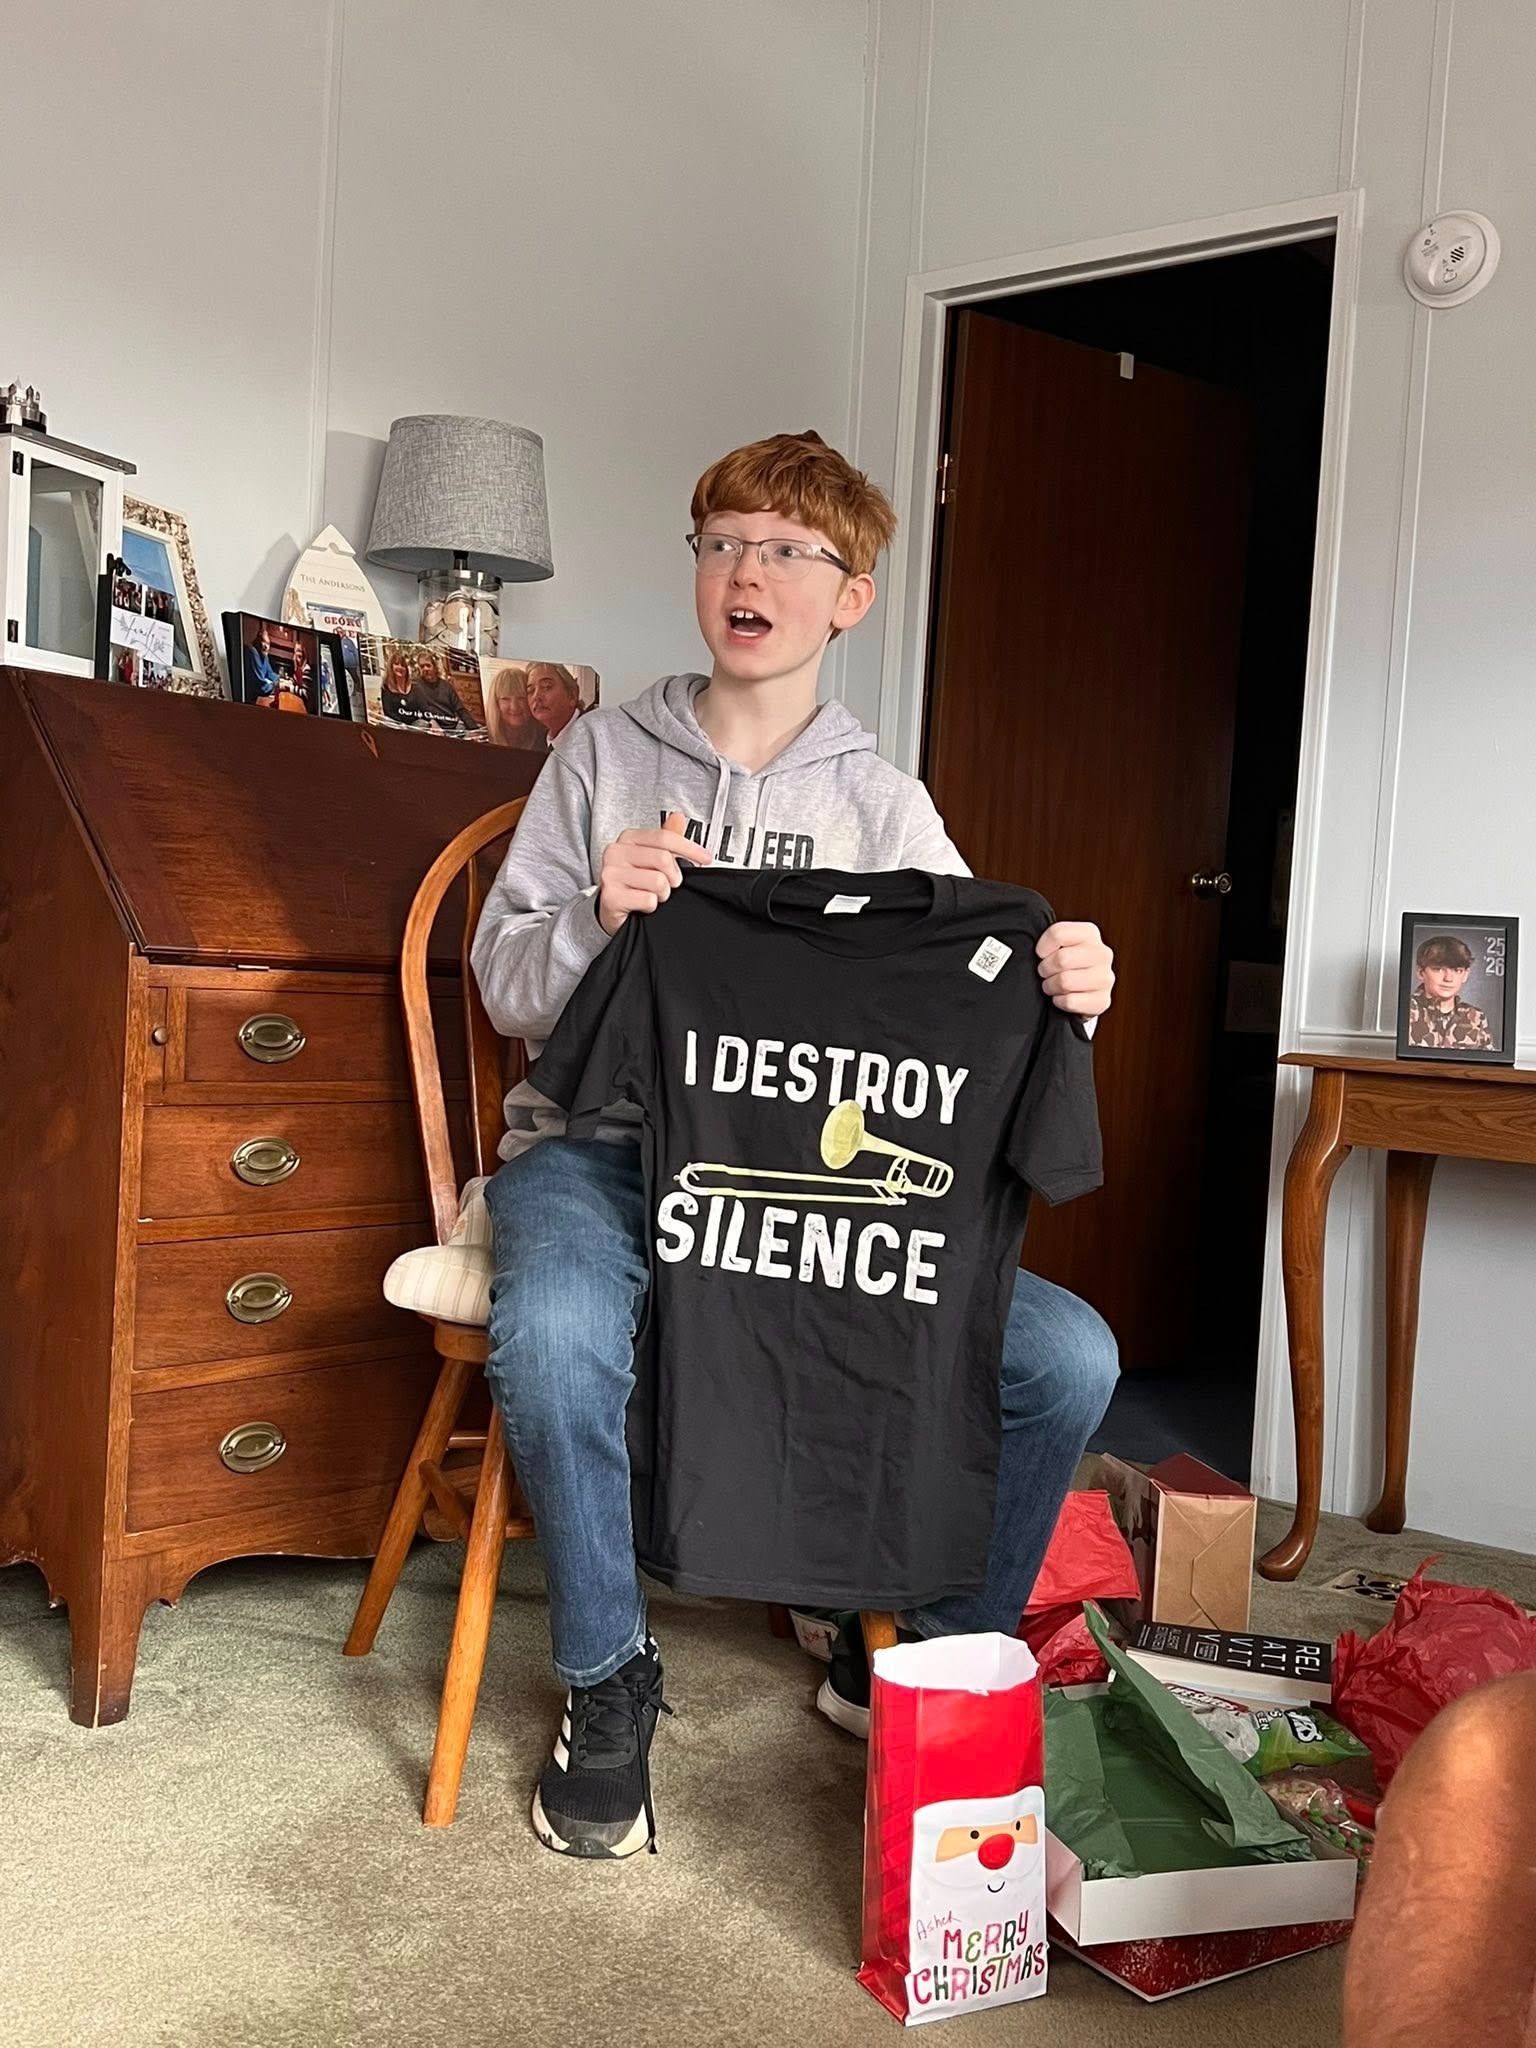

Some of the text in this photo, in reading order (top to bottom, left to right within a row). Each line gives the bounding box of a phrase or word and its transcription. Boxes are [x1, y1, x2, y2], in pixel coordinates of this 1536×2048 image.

[300, 574, 365, 592] THE ANDERSONS
[684, 1030, 969, 1124] I DESTROY
[656, 1191, 946, 1305] SILENCE
[943, 1910, 1029, 1963] MERRY
[913, 1942, 1045, 2005] CHRISTMAS
